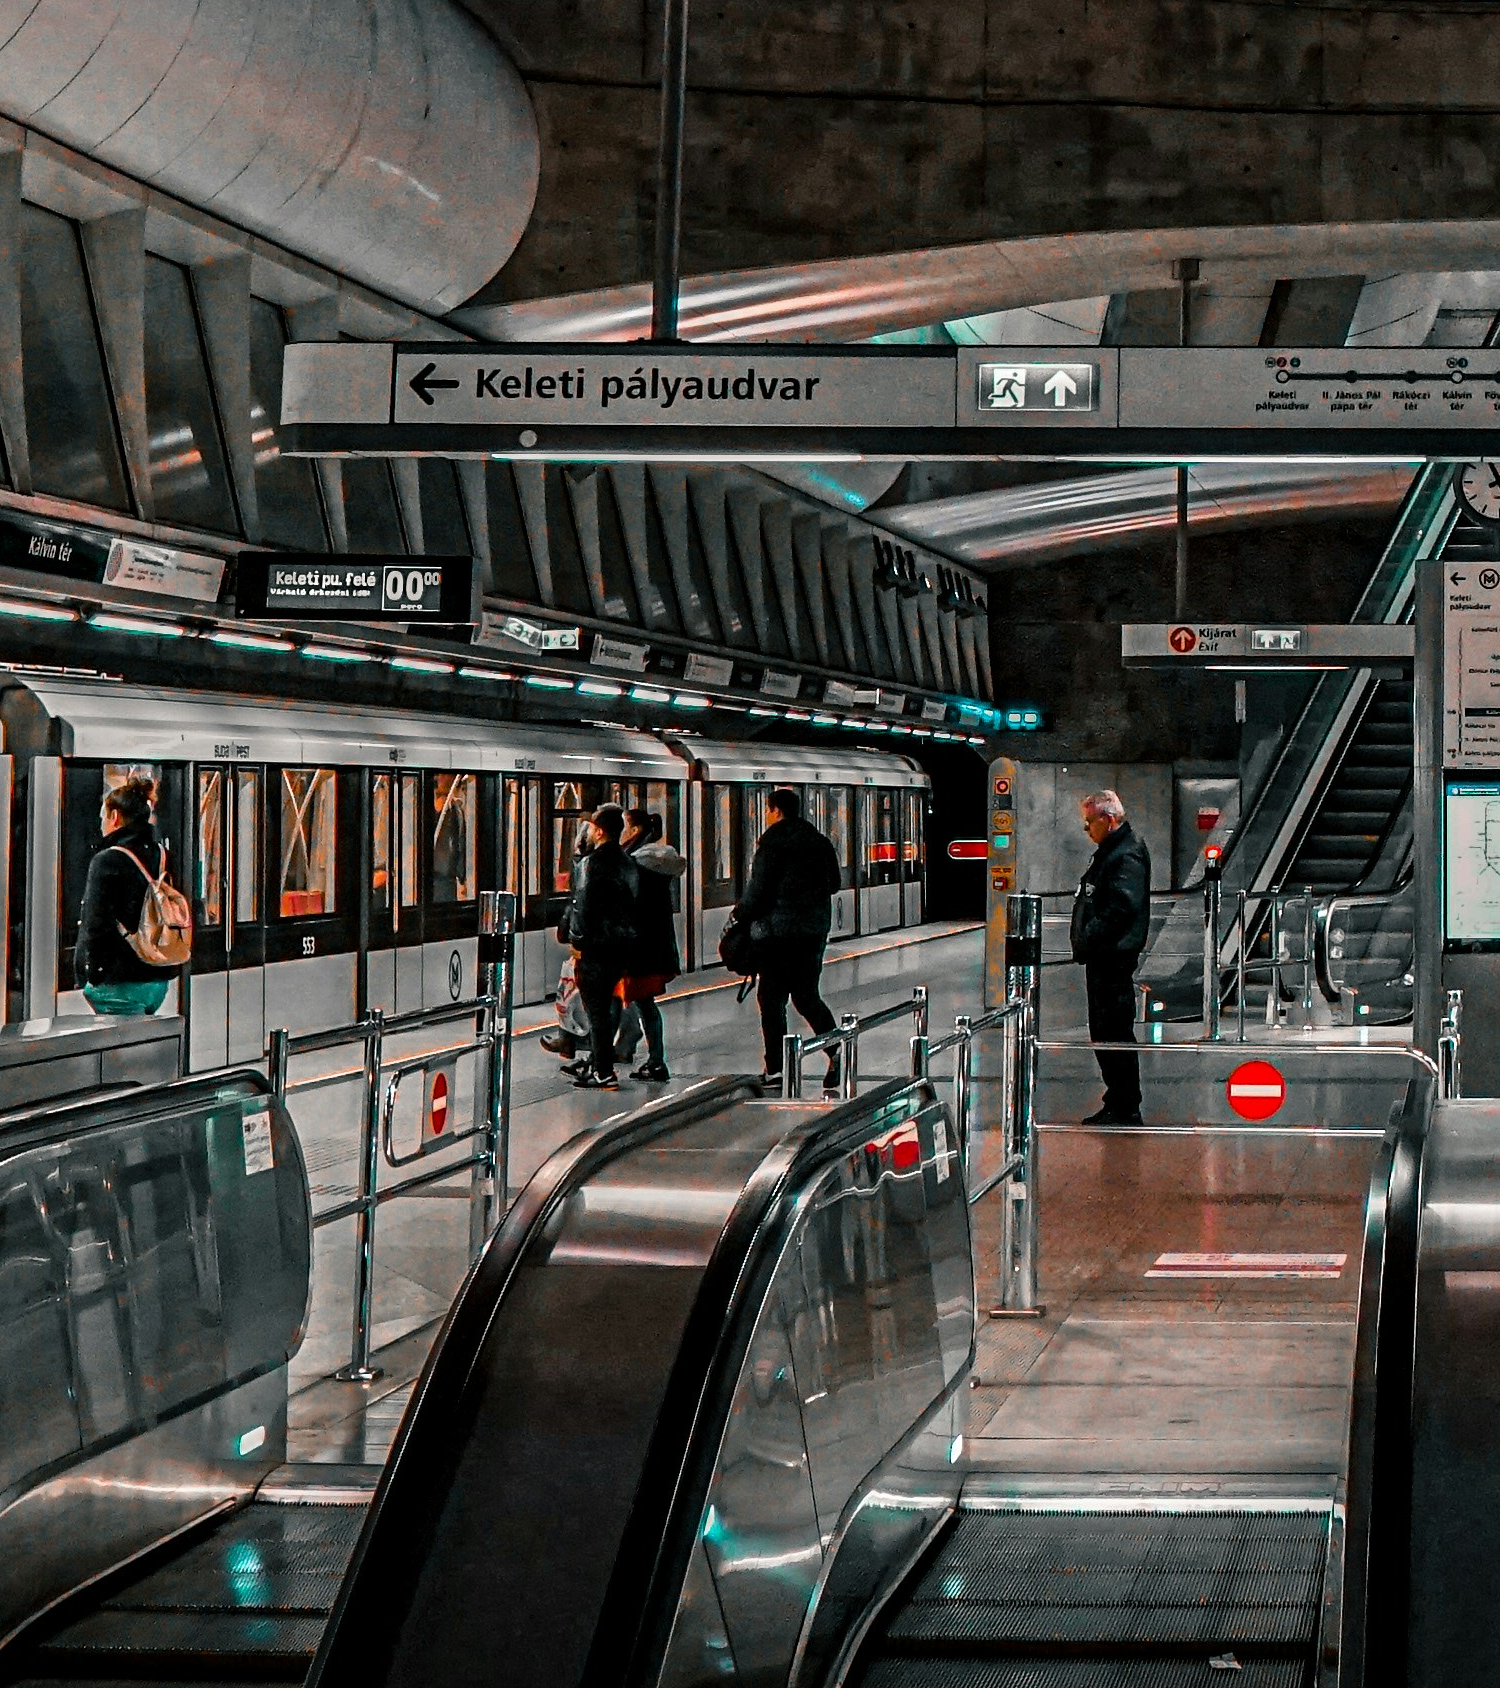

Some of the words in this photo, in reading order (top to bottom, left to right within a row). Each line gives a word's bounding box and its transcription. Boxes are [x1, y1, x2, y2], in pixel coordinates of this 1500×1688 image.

[475, 368, 586, 401] Keleti
[601, 368, 820, 408] pályaudvar
[28, 535, 57, 558] Kálvin
[58, 541, 72, 561] tér
[276, 571, 319, 586] Keleti
[322, 574, 342, 588] pu.
[345, 571, 376, 587] felé
[386, 570, 423, 601] 00
[1199, 628, 1237, 640] Kijárat
[1199, 642, 1219, 651] Exit
